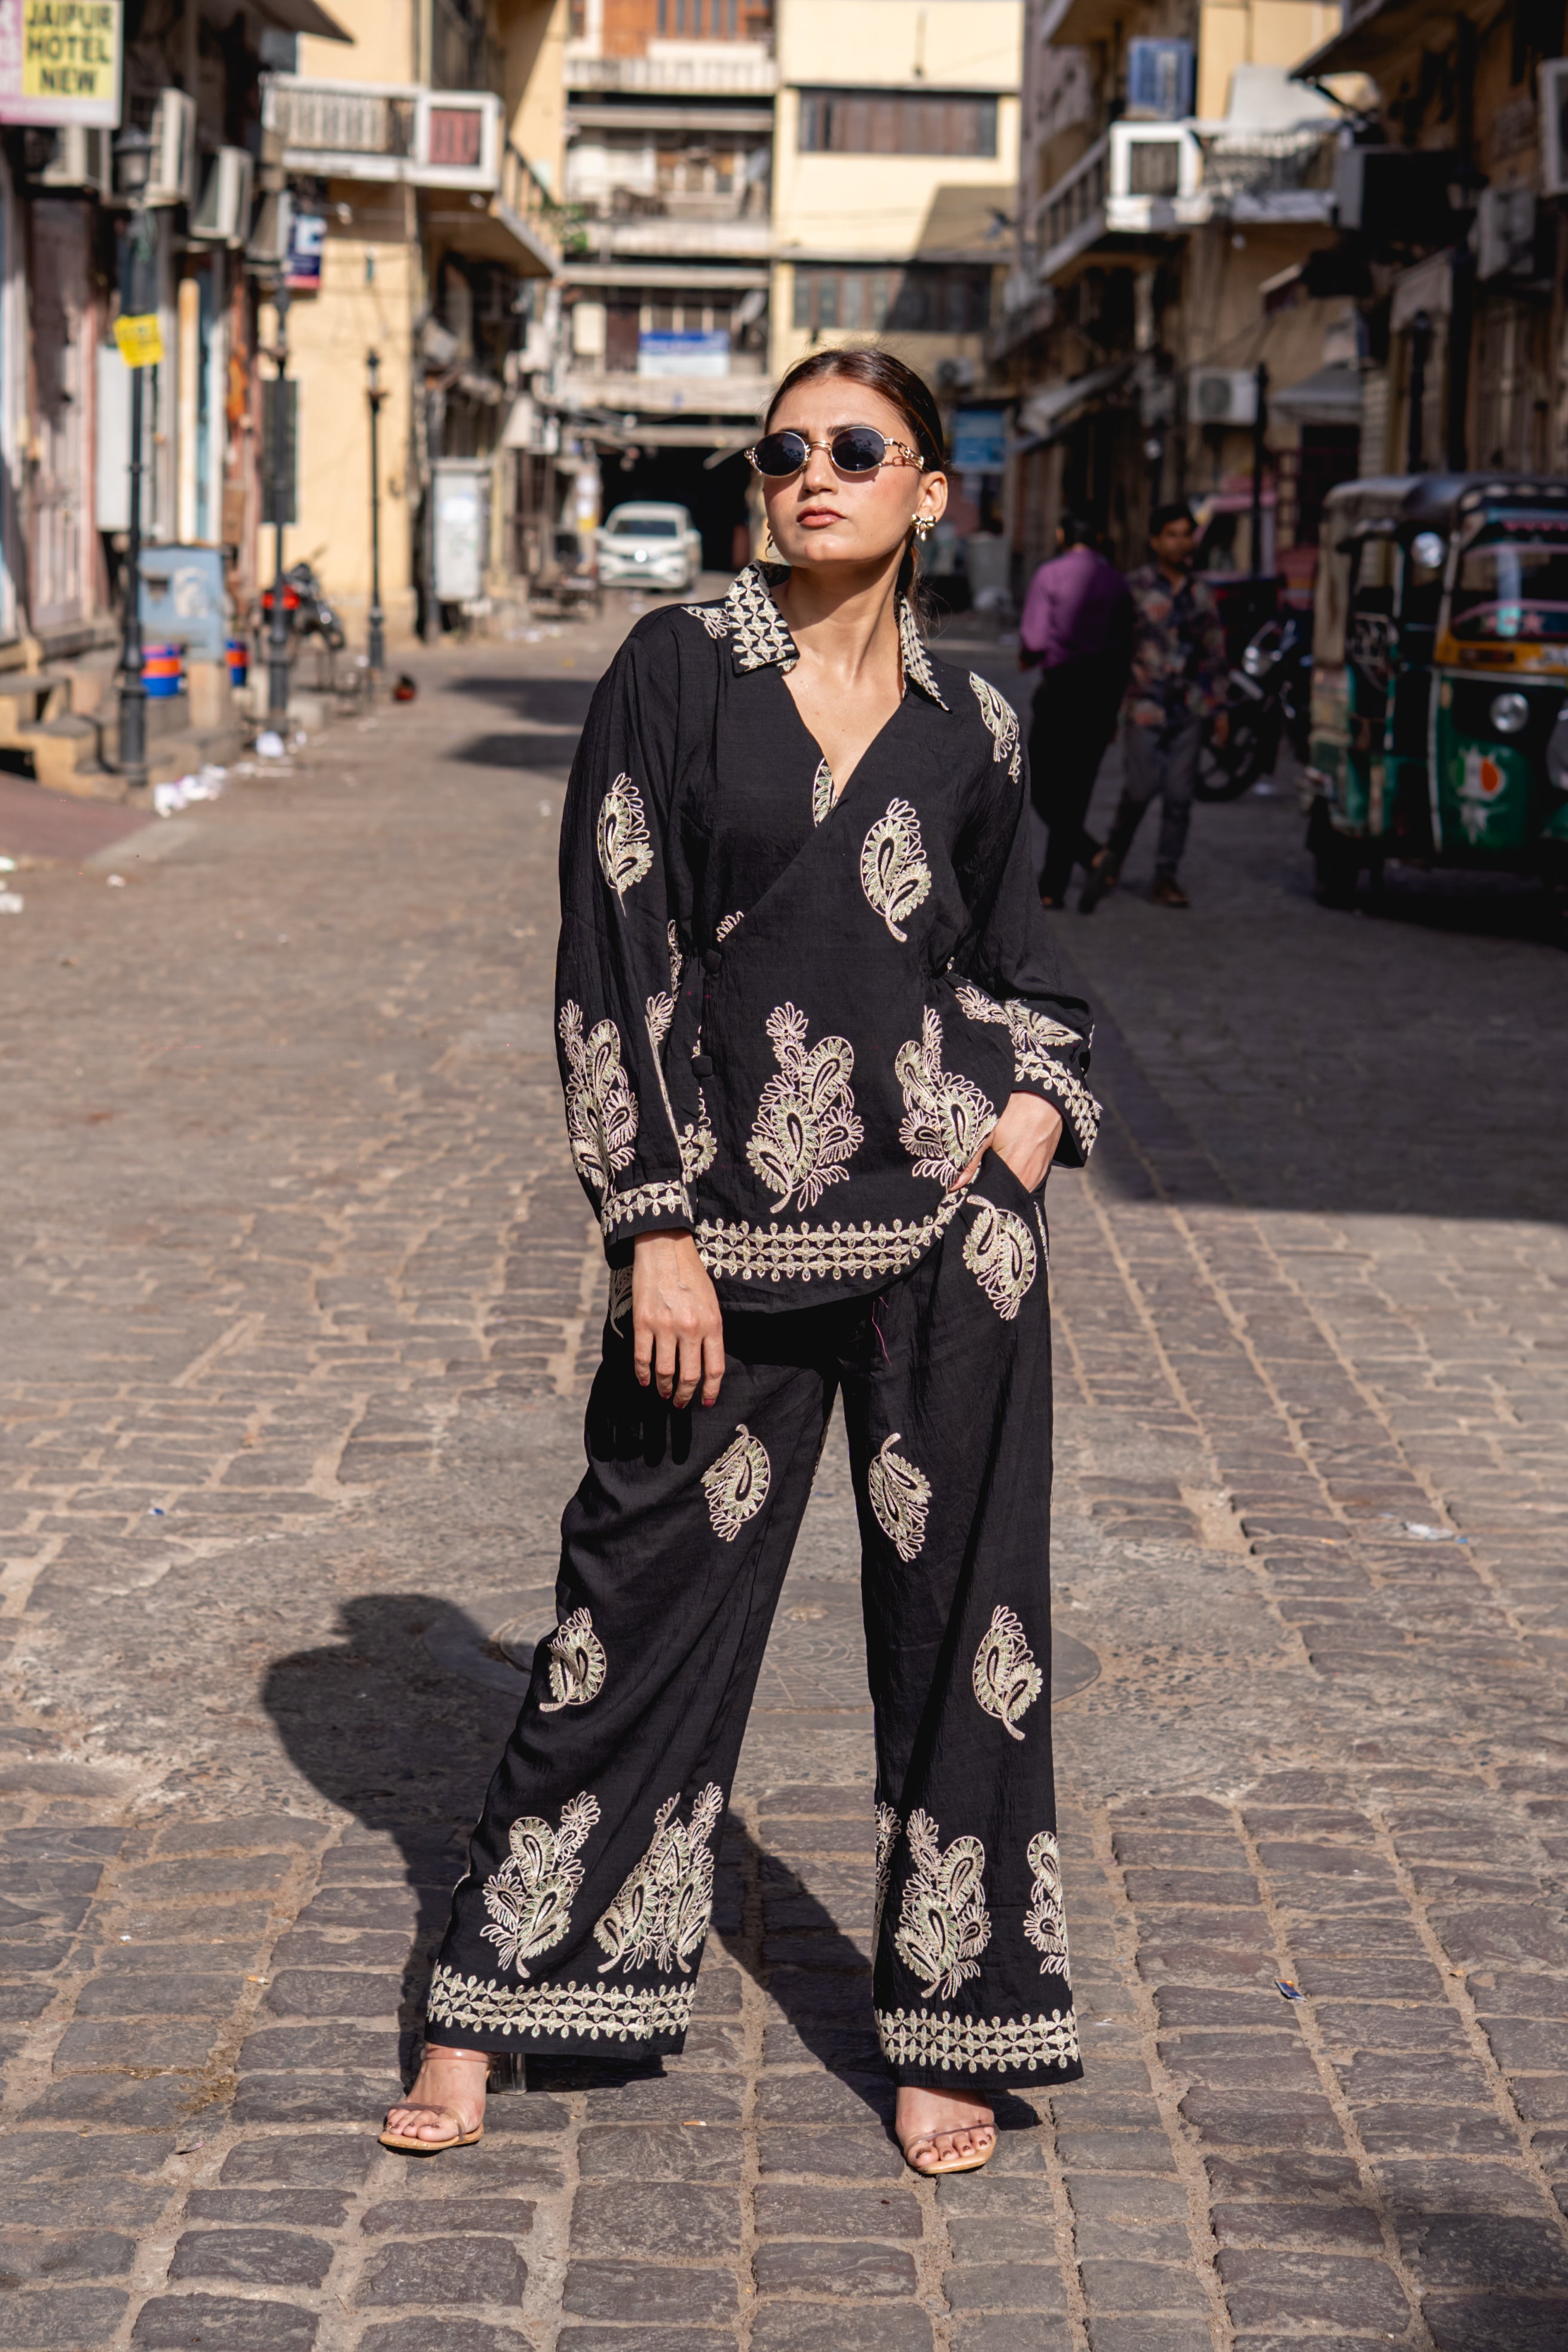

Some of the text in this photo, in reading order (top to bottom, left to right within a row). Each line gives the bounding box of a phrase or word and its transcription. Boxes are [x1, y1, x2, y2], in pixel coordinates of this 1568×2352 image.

[27, 5, 112, 30] JAIPUR
[27, 36, 111, 63] HOTEL
[40, 68, 98, 94] NEW
